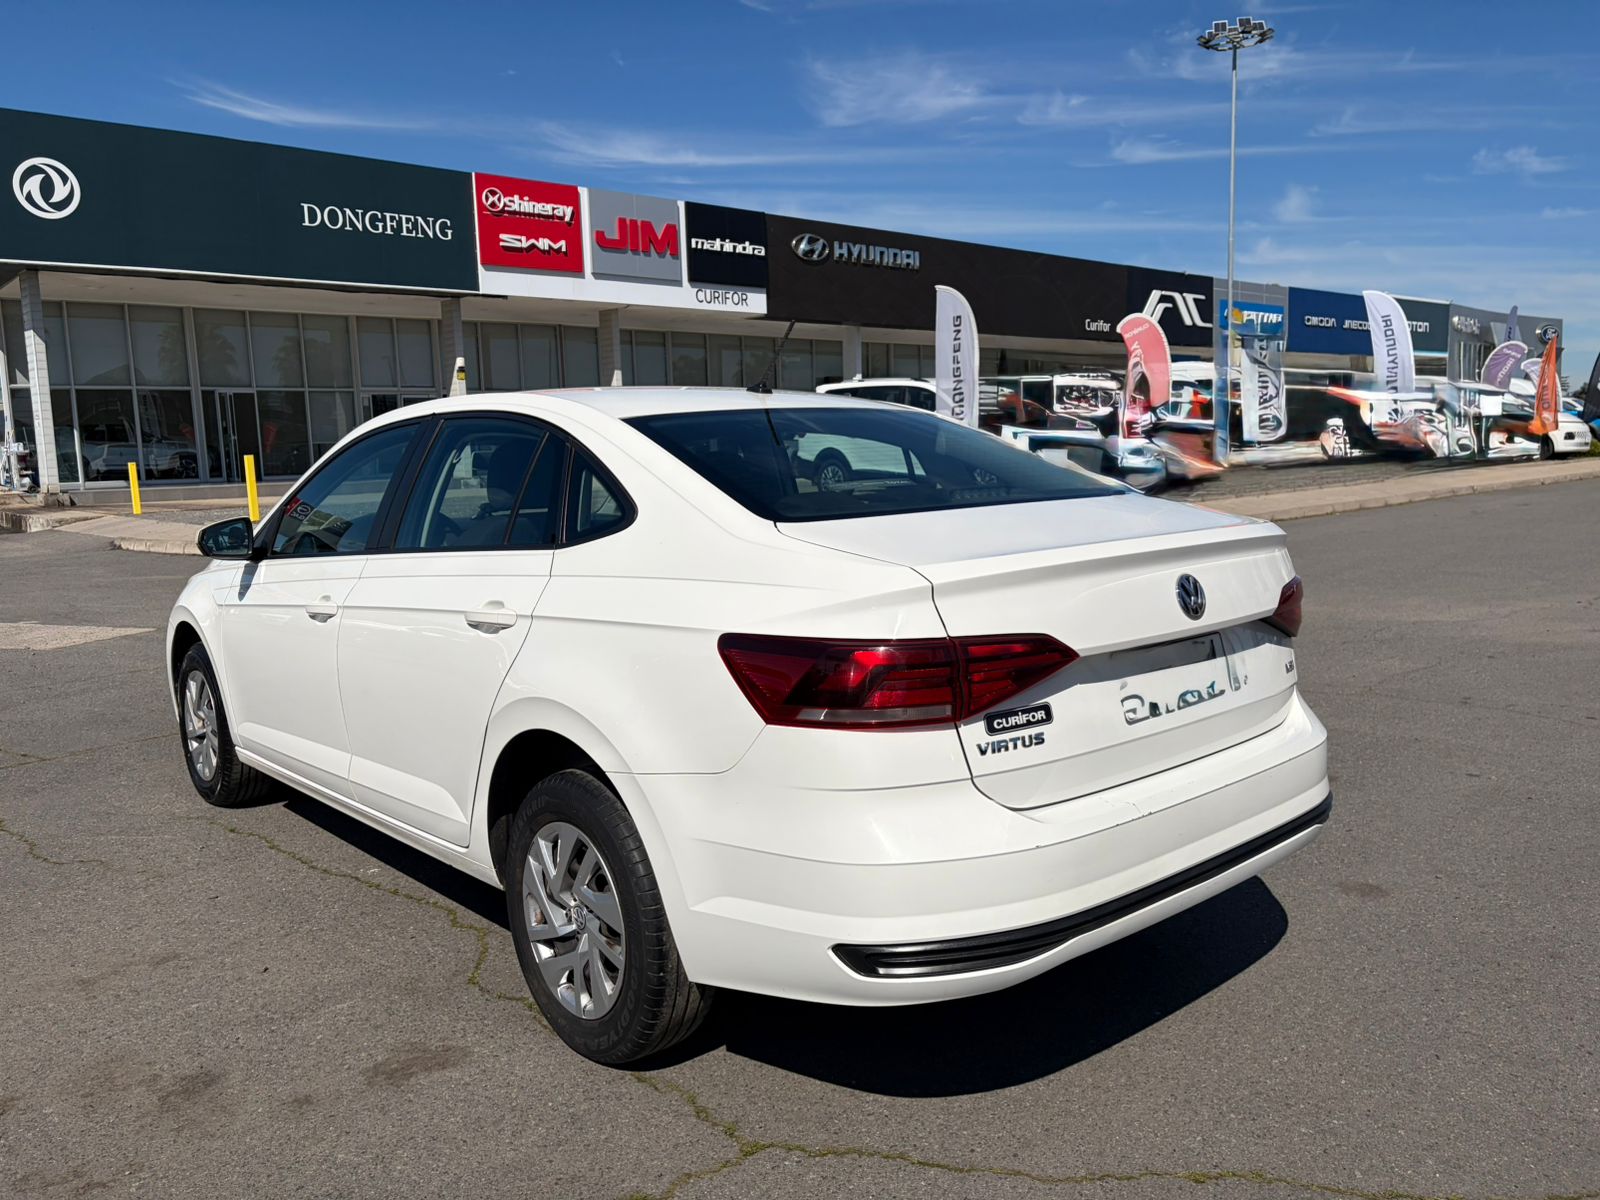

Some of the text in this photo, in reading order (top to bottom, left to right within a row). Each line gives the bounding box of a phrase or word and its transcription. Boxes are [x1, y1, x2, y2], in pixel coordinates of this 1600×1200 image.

[504, 195, 573, 222] shineray
[300, 203, 453, 240] DONGFENG
[499, 233, 567, 252] SWM
[595, 217, 679, 257] JIM
[691, 237, 766, 257] mahindra
[833, 241, 920, 270] HYUNDAI
[695, 288, 749, 306] CURIFOR
[1085, 318, 1111, 332] Curifor
[976, 732, 1046, 756] VIRTUS
